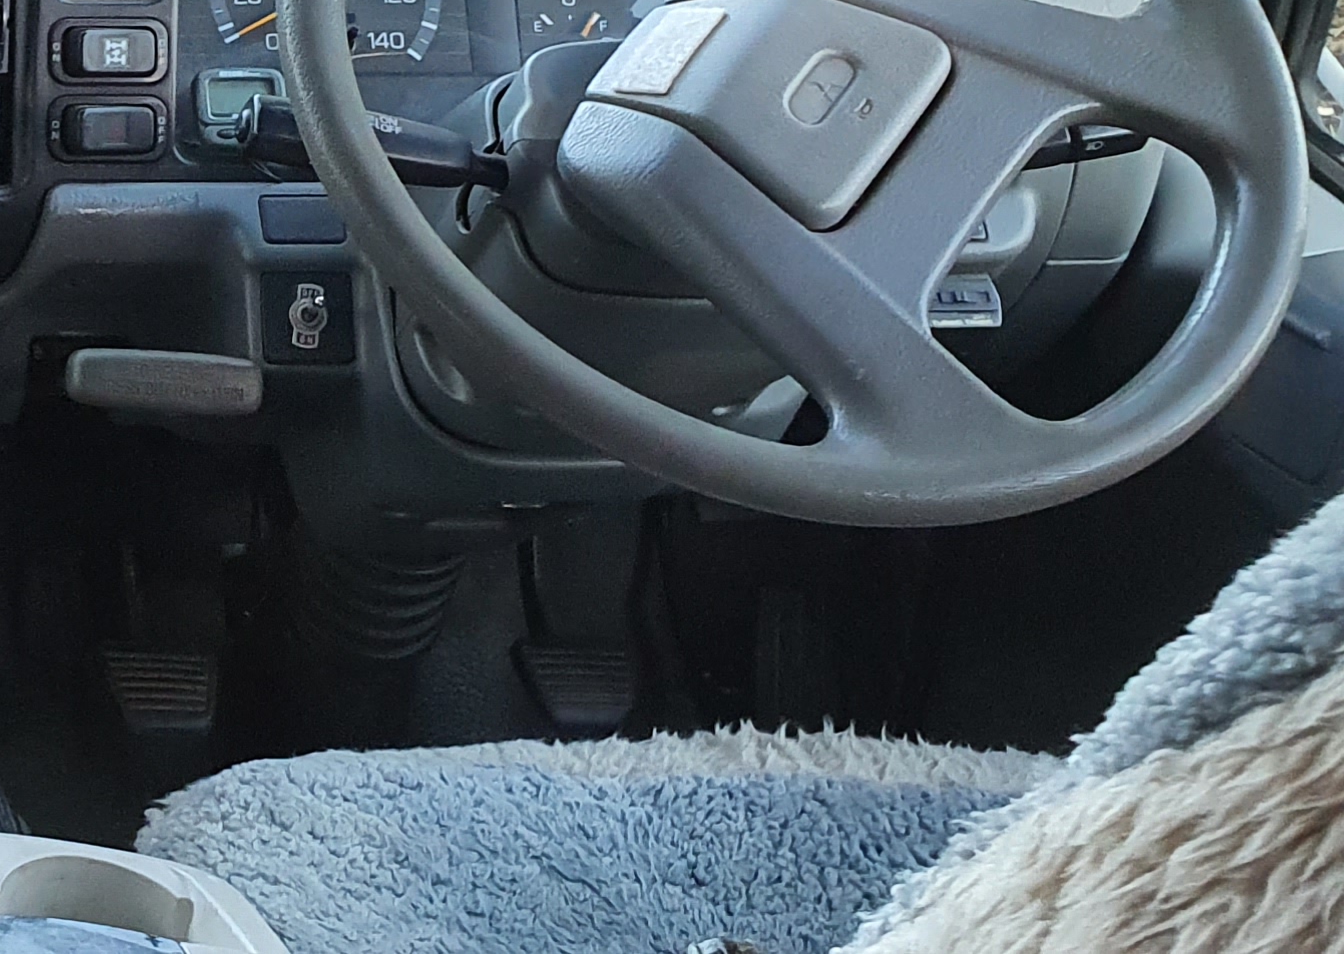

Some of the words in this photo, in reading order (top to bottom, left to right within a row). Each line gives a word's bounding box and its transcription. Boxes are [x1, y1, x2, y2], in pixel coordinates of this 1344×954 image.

[534, 20, 543, 33] E
[600, 20, 608, 32] F
[265, 33, 279, 51] 0
[367, 32, 405, 50] 140
[52, 42, 61, 62] ON
[52, 120, 60, 140] ON
[157, 116, 166, 143] OFF
[379, 116, 398, 127] ON
[380, 123, 402, 134] OFF
